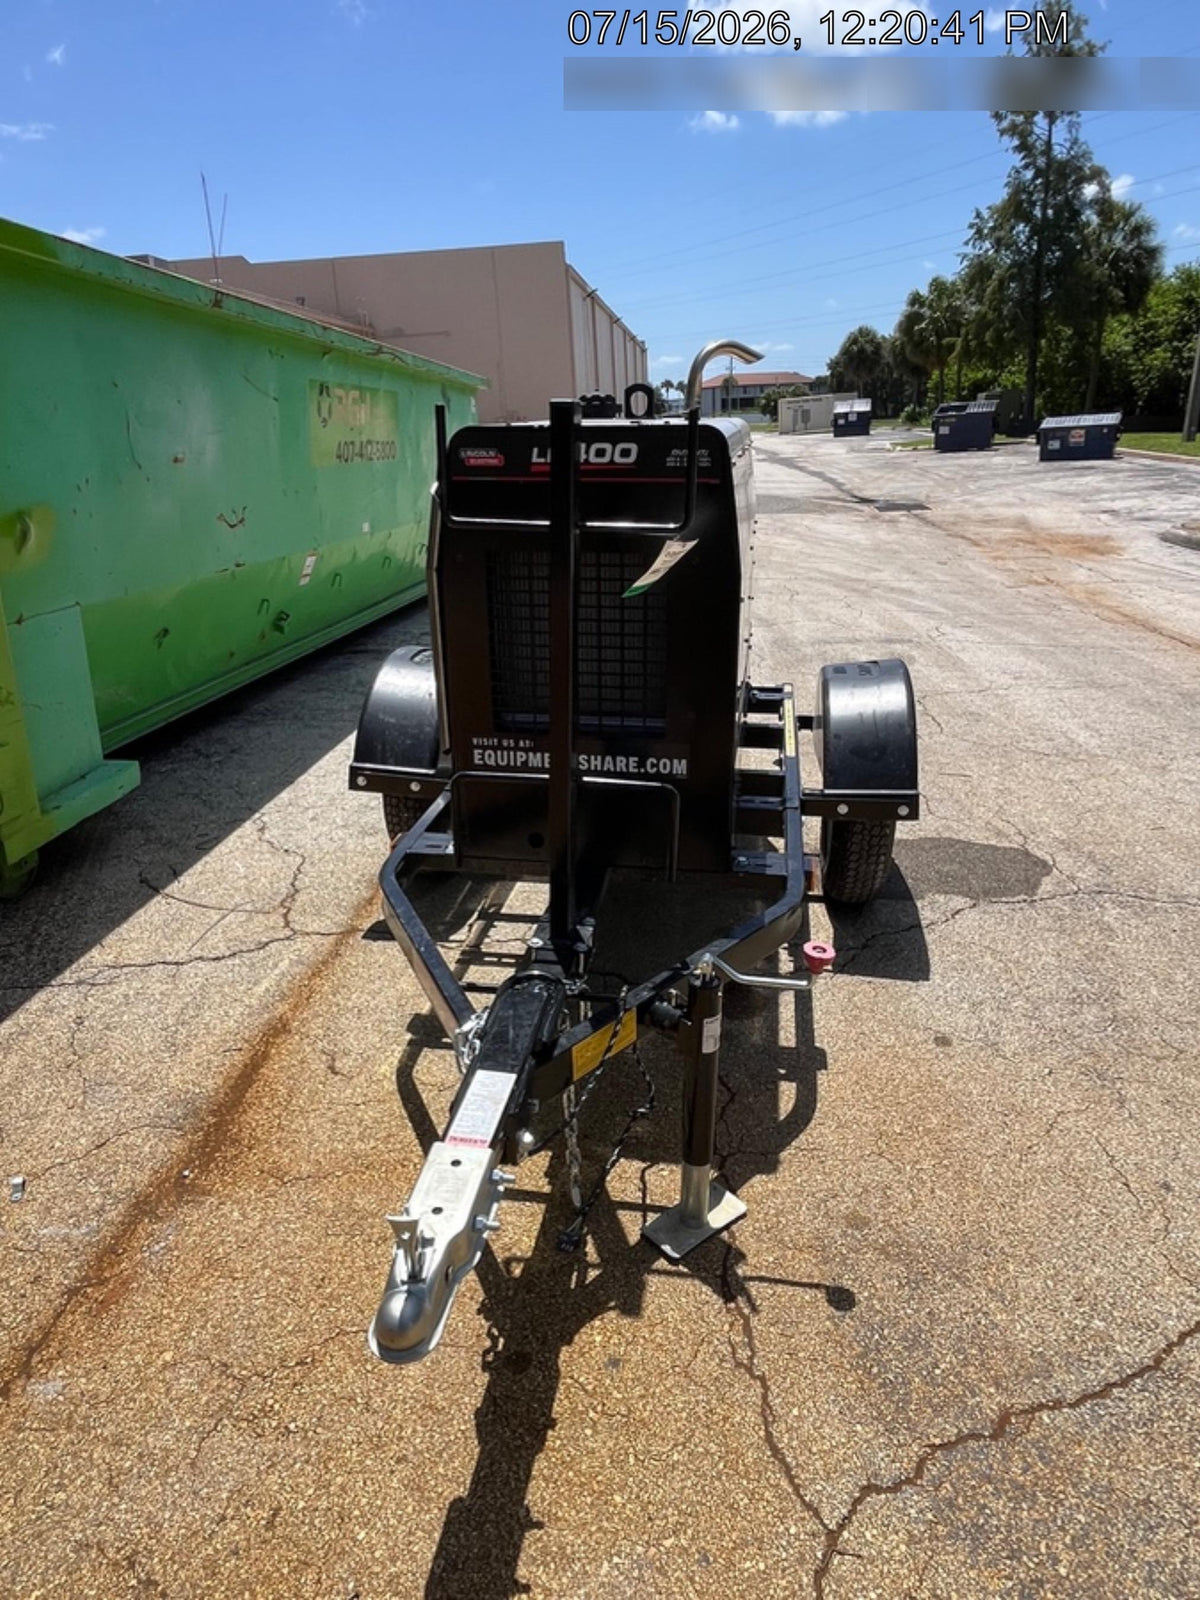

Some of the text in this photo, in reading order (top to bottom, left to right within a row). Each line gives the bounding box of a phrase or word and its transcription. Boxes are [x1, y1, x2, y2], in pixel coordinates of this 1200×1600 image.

[473, 737, 499, 747] VISIT
[502, 738, 515, 748] US
[473, 749, 688, 775] EQUIPMESHARE.COM
